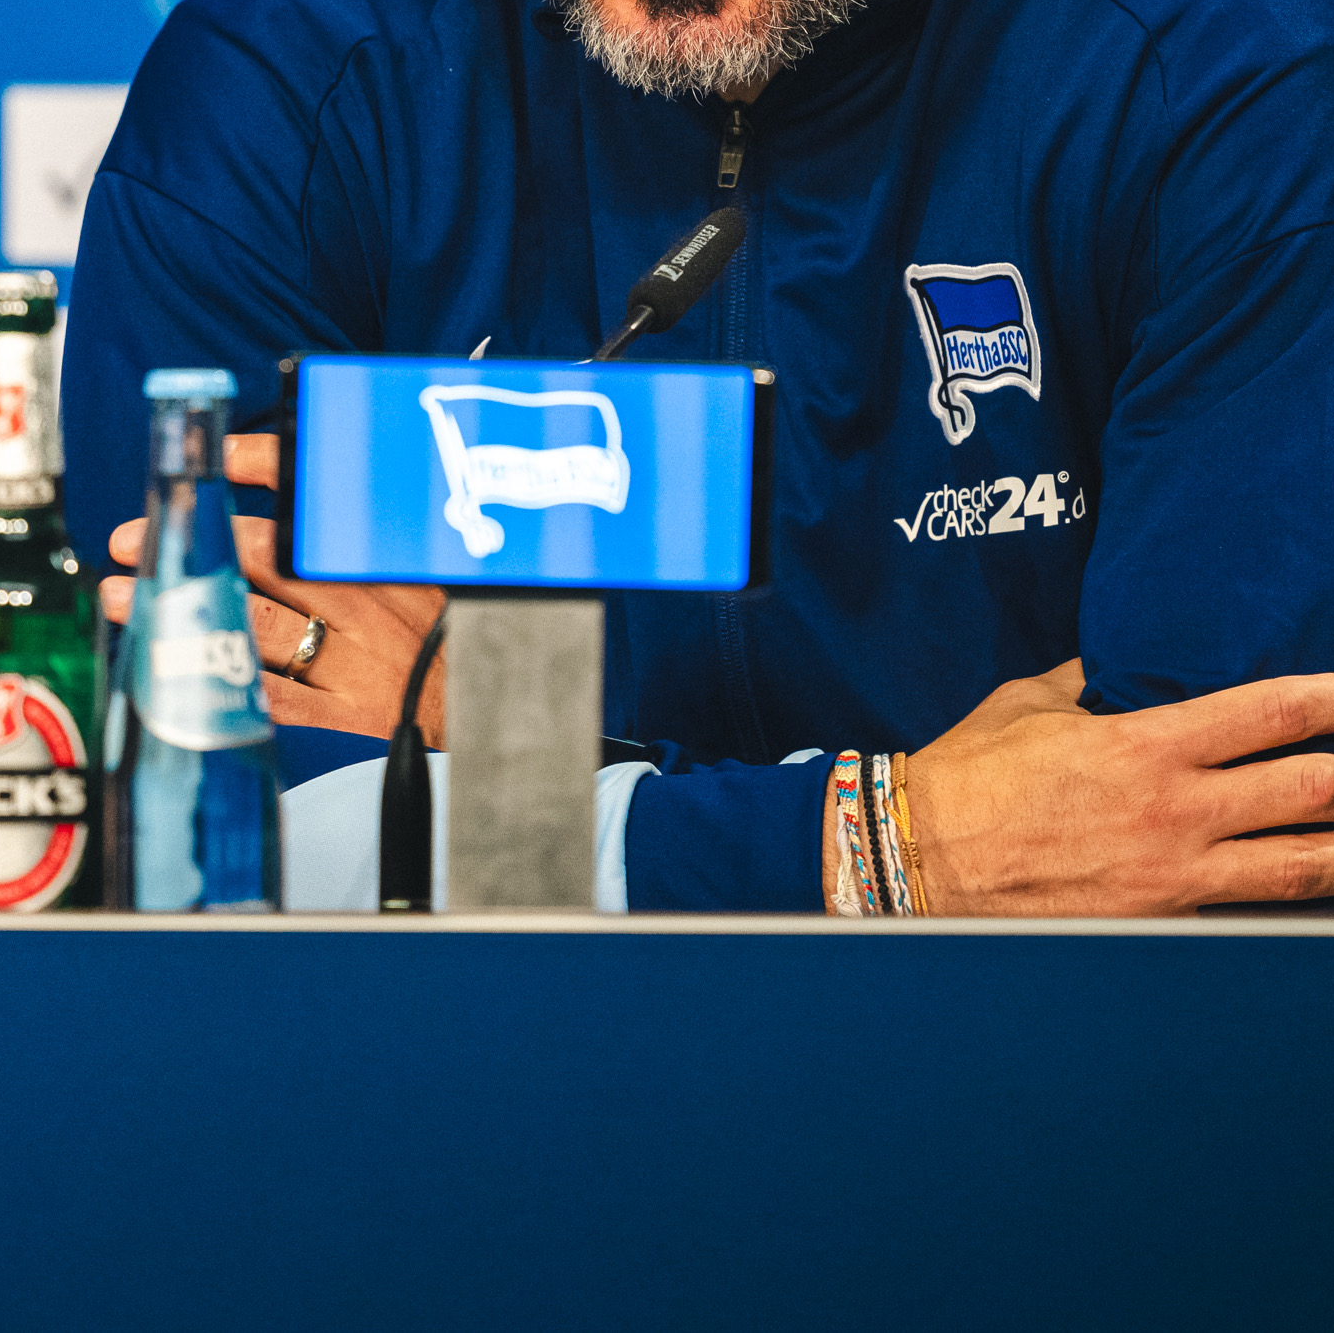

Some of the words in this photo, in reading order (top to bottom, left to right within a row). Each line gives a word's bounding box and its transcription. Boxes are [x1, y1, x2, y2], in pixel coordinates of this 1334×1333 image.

[670, 223, 722, 269] SENNHEISER
[933, 478, 996, 514] check
[927, 506, 987, 541] CARS
